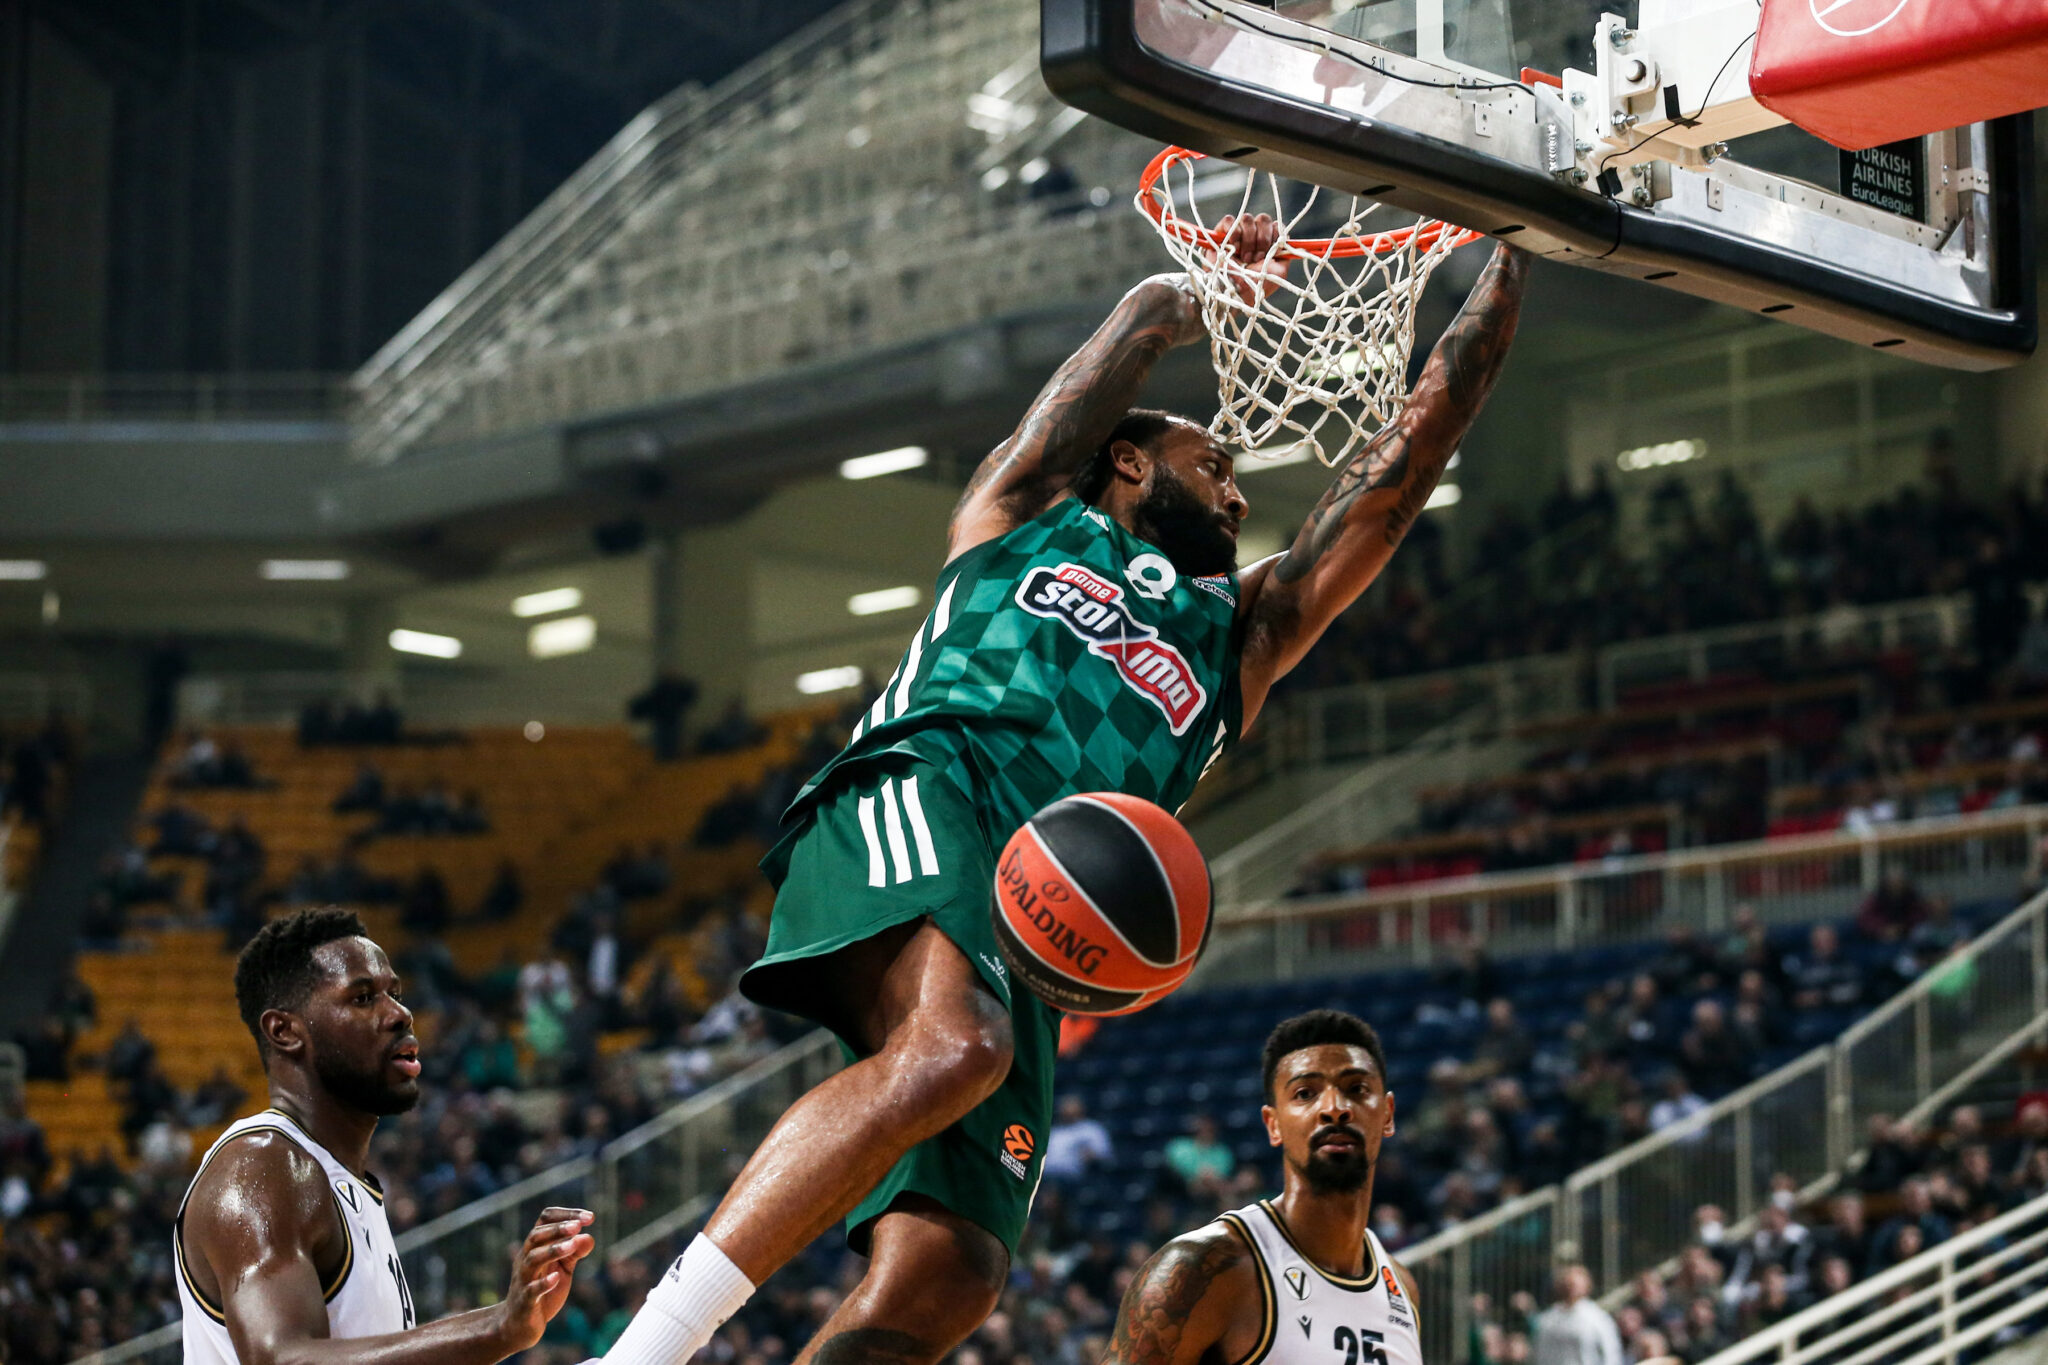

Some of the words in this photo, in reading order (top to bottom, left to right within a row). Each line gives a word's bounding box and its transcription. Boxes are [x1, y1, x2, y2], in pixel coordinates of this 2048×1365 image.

[1852, 162, 1913, 197] AIRLINES
[1851, 181, 1914, 216] EuroLeague
[1062, 568, 1112, 599] pame
[1000, 847, 1109, 976] SPALDING
